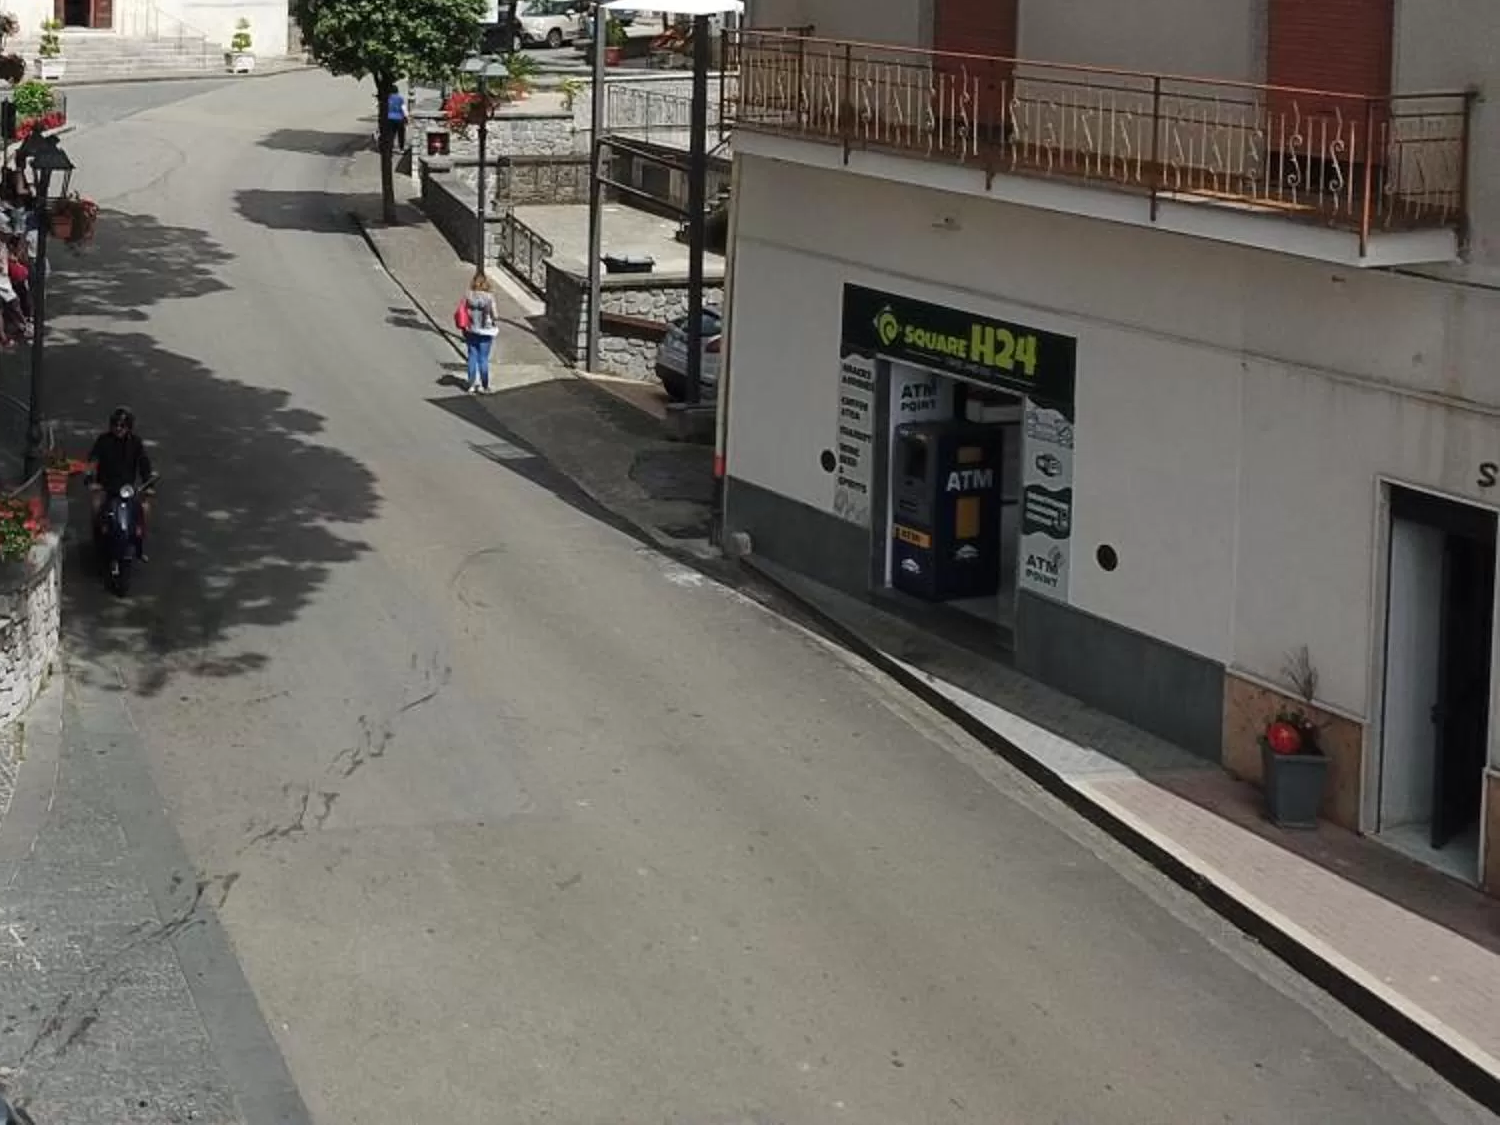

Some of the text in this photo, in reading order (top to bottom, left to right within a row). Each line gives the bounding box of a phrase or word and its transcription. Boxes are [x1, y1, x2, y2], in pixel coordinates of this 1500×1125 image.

[904, 325, 968, 359] SQUARE
[970, 322, 1037, 376] H24
[902, 382, 937, 398] ATM
[901, 399, 937, 412] POINT
[946, 469, 994, 492] ATM
[1476, 462, 1499, 488] S
[1026, 554, 1059, 575] ATM
